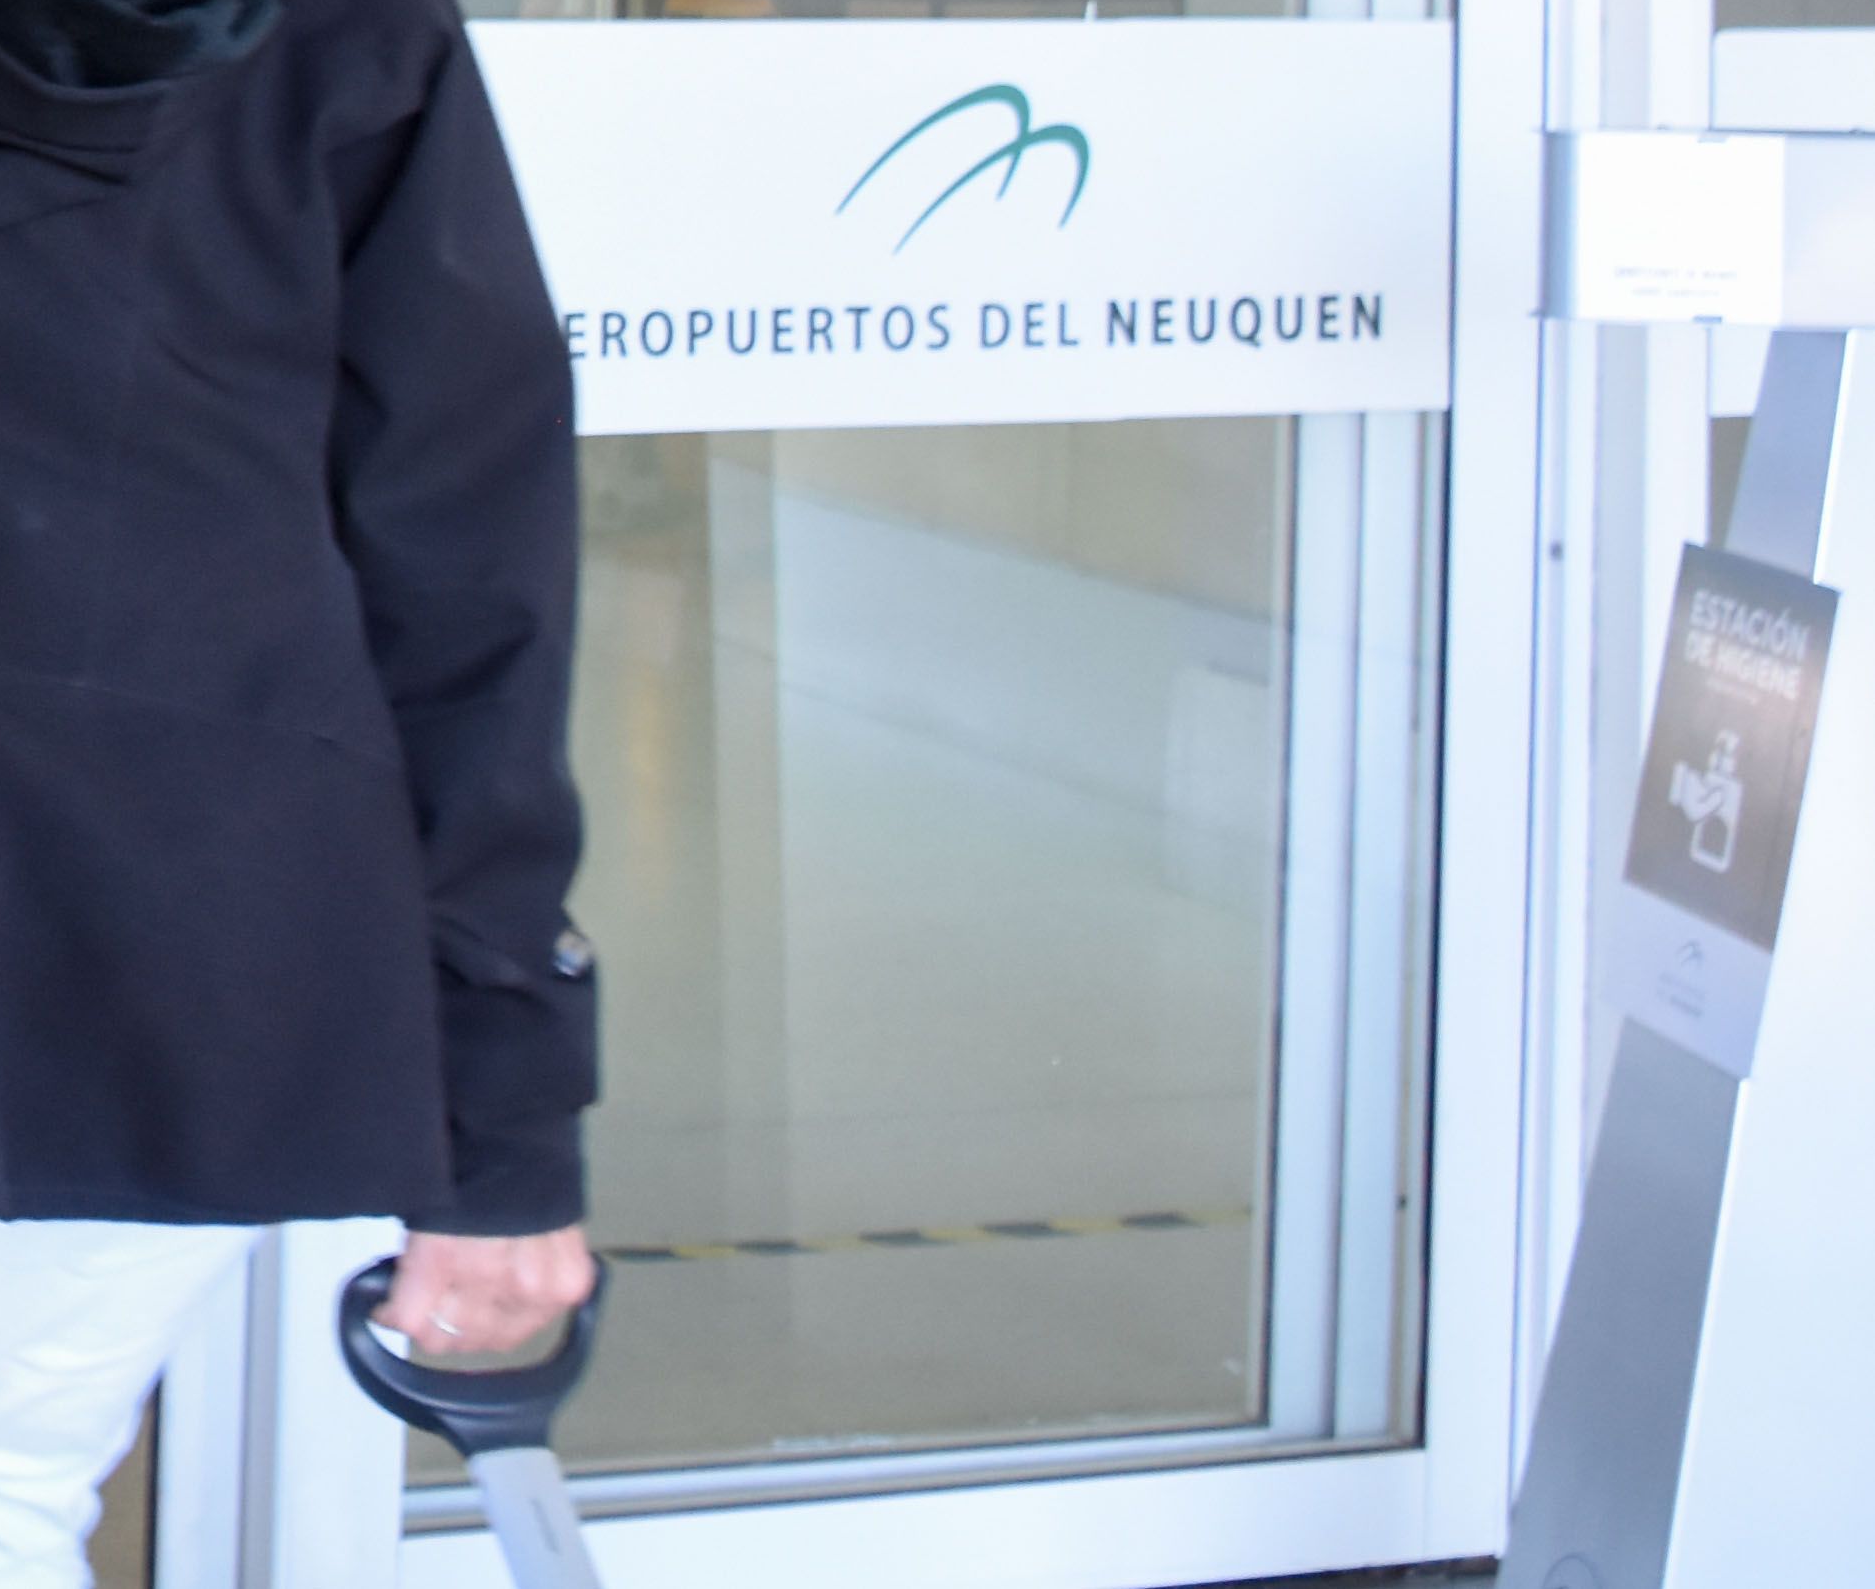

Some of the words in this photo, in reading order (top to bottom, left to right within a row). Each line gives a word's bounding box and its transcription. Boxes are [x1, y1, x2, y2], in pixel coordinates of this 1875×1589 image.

[565, 304, 953, 360] EROPUERTOS
[980, 302, 1081, 351] DEL
[1108, 294, 1385, 349] NEUQUEN
[1690, 589, 1810, 664] ESTACIÓN
[1714, 641, 1802, 701] HIGIENE
